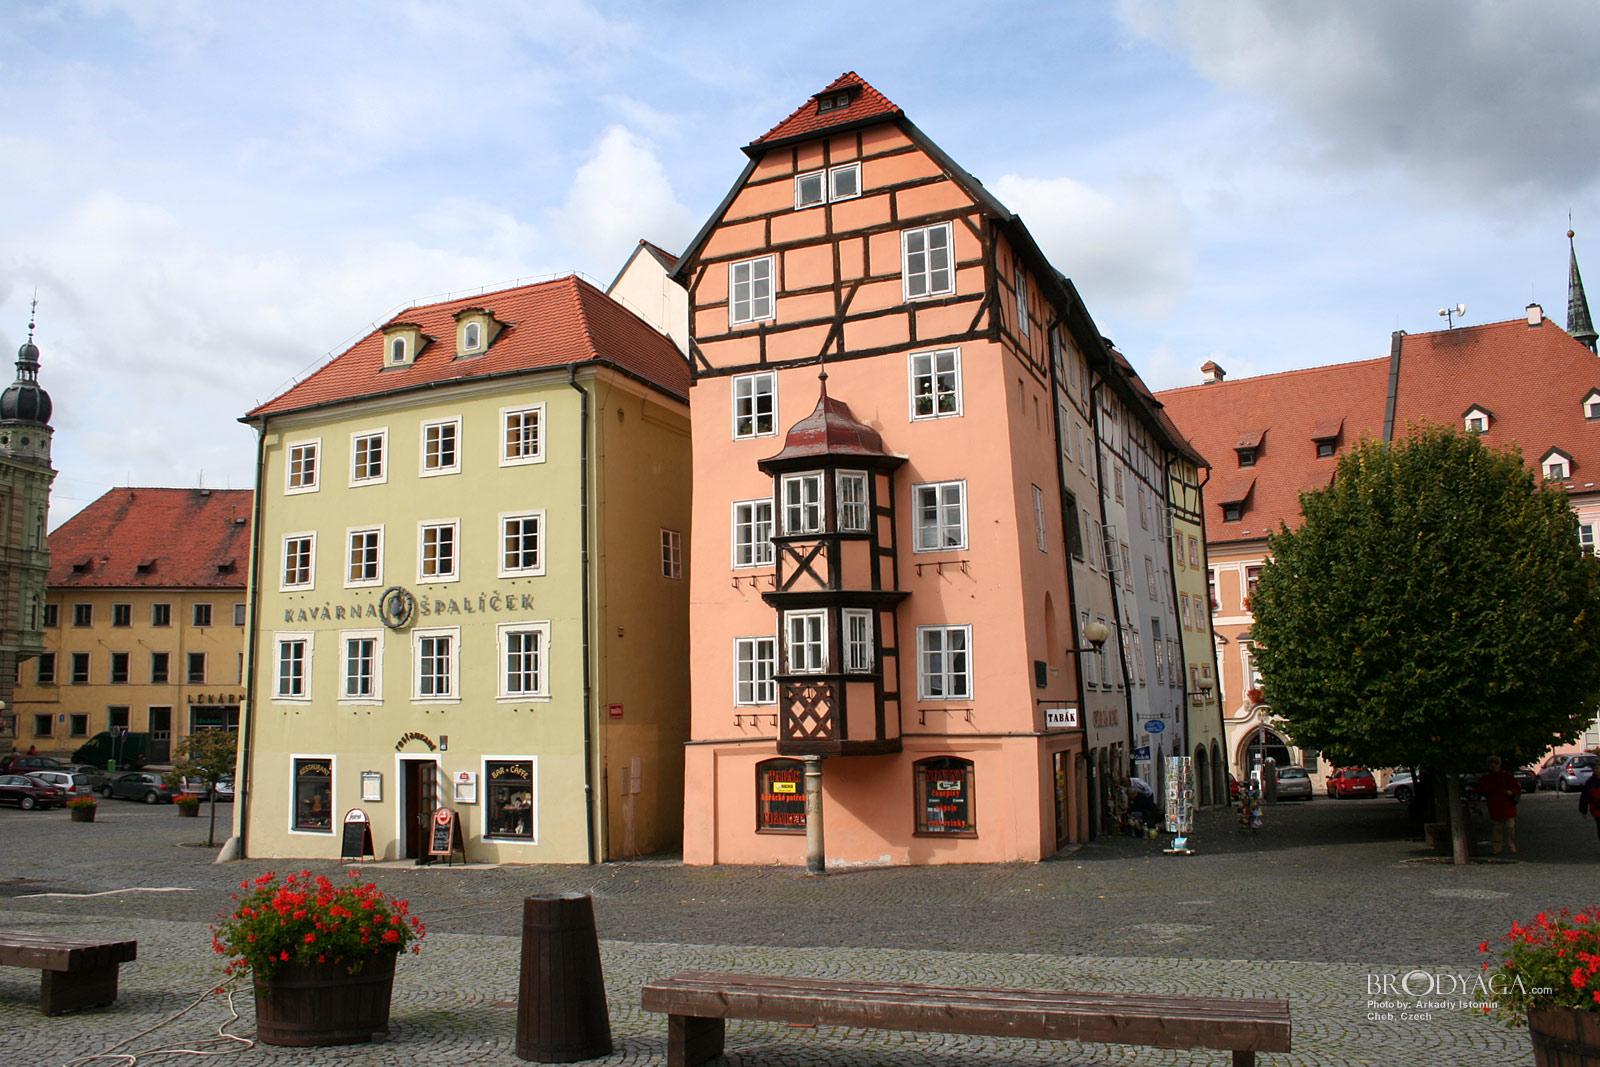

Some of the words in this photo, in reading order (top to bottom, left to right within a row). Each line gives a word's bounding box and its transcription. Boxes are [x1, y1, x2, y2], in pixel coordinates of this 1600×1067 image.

[284, 601, 378, 623] KAVÁRNA
[419, 590, 534, 616] ŠPALÍČEK
[1048, 712, 1075, 722] TABÁK
[395, 732, 437, 752] restaurant
[299, 764, 330, 776] RESTAURANT
[491, 766, 505, 779] BAR
[510, 765, 529, 780] CAFFE
[769, 768, 800, 782] TABÁK
